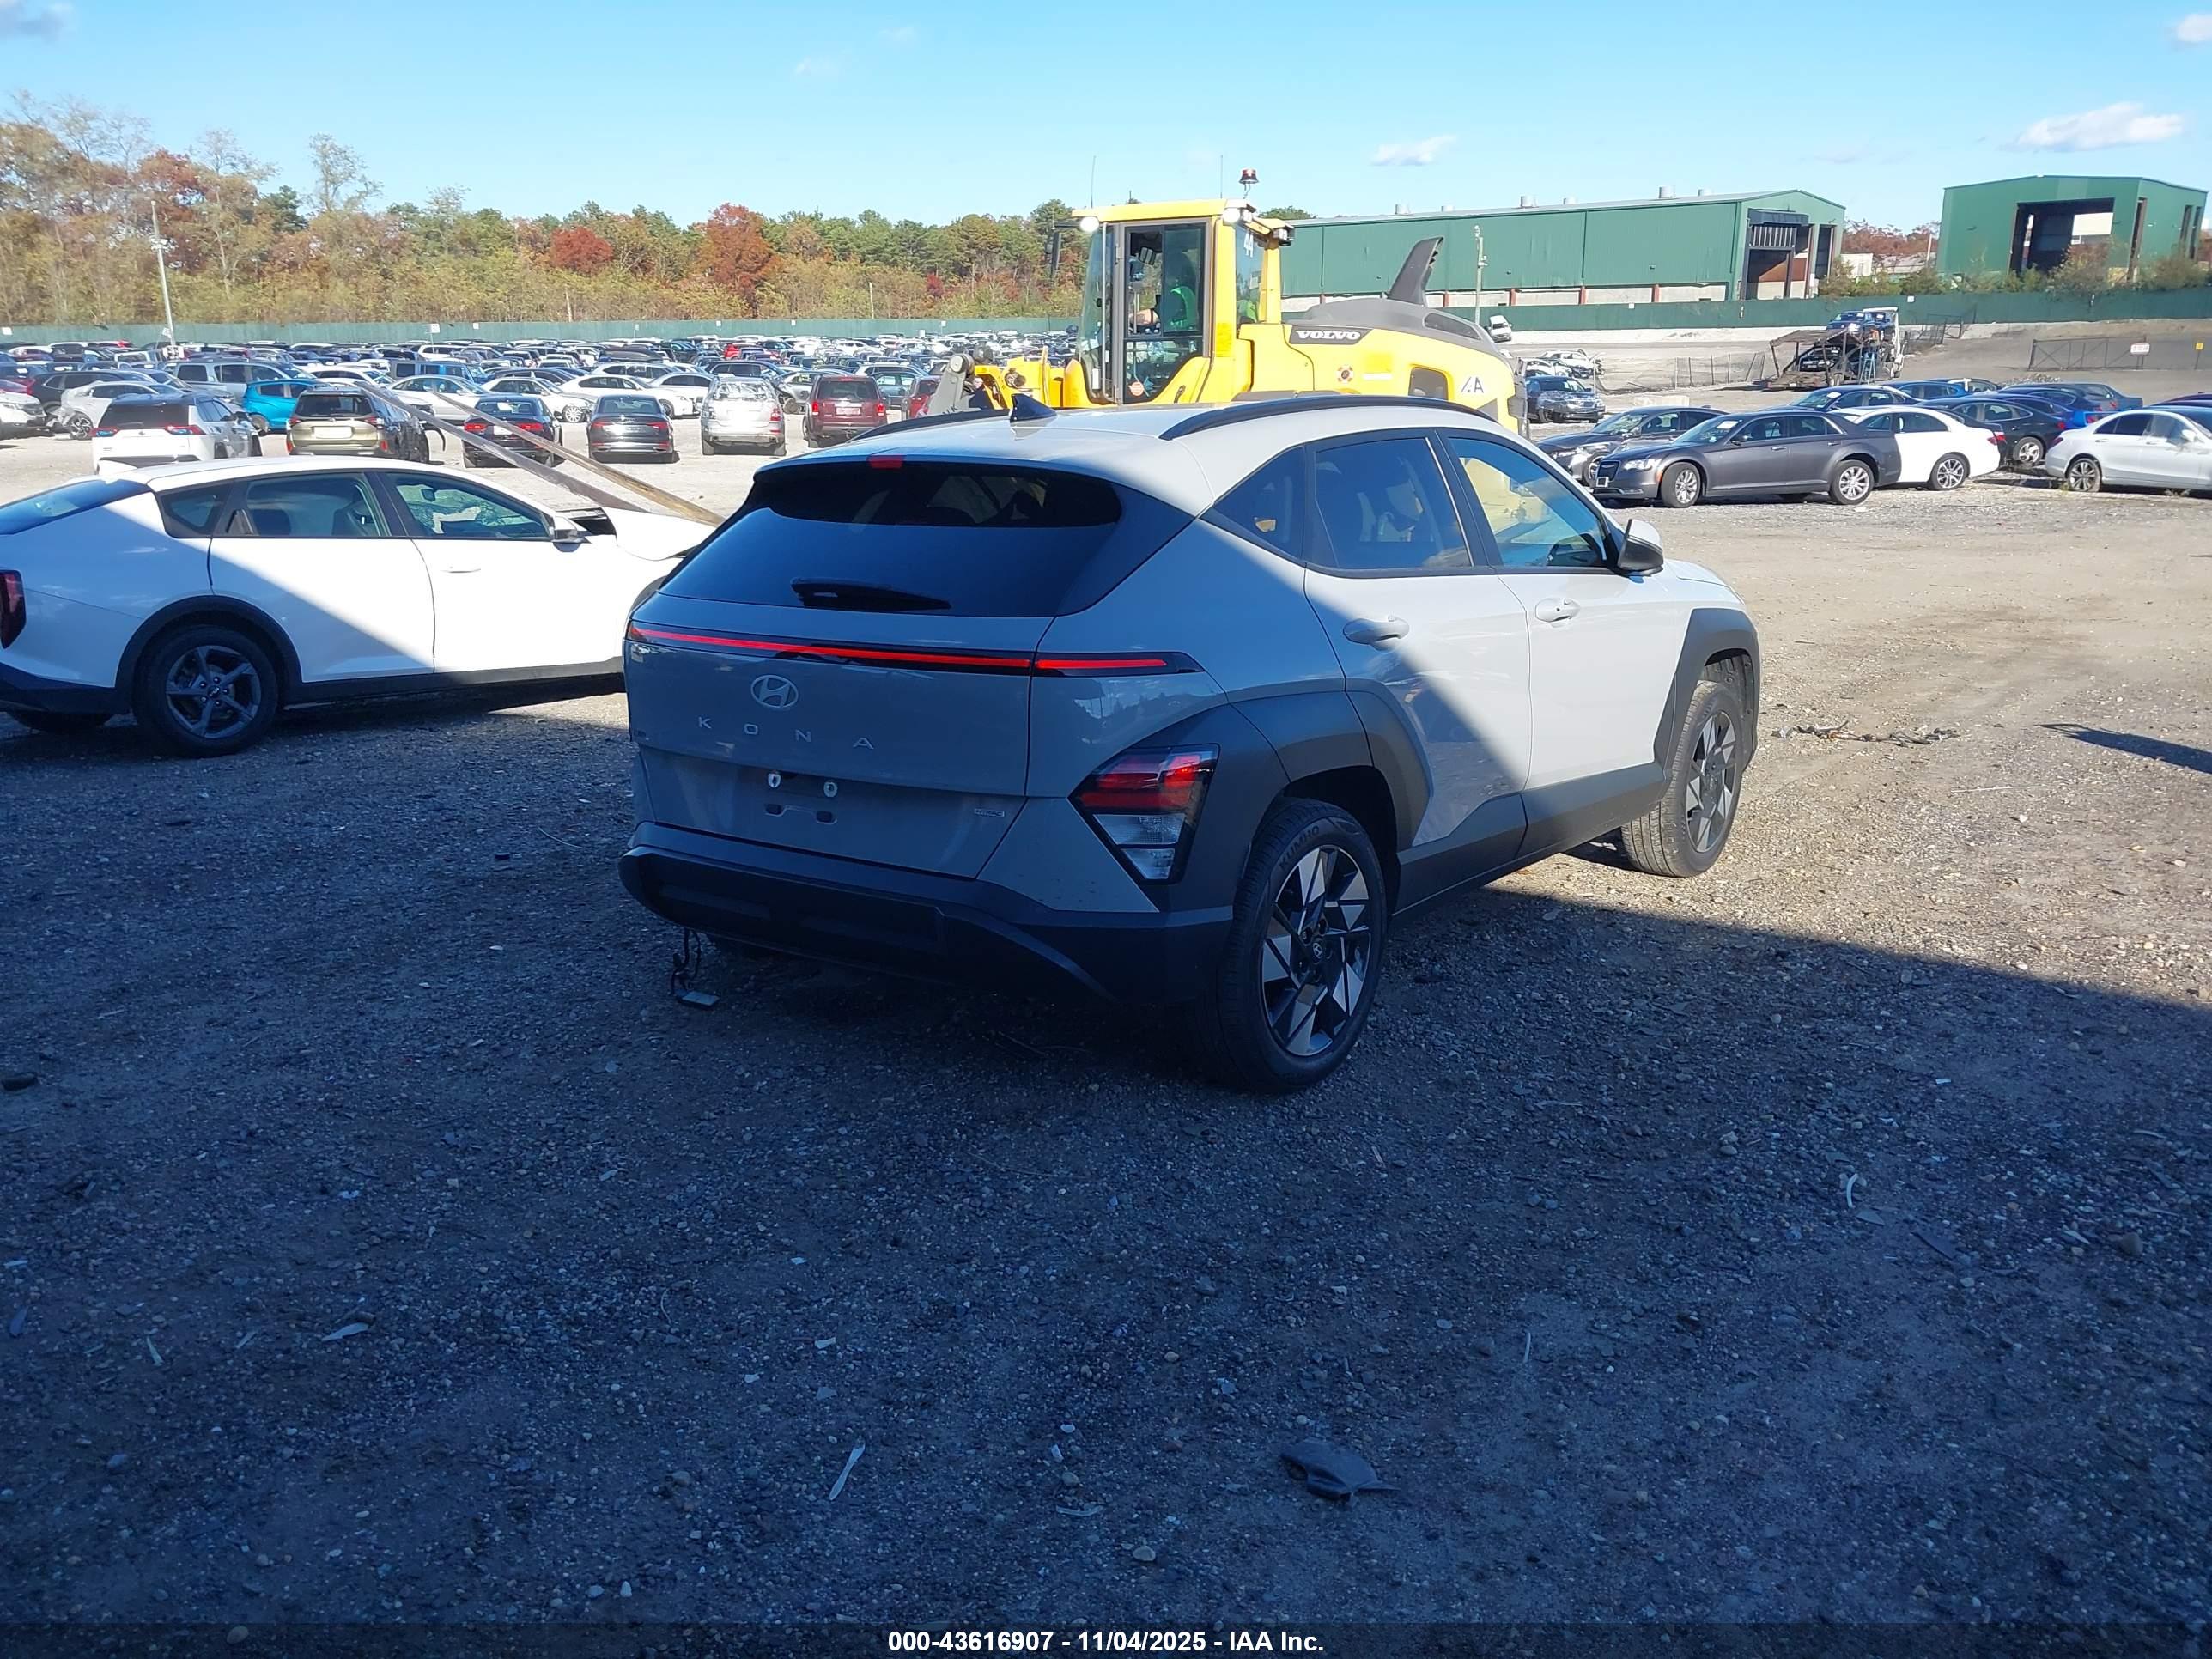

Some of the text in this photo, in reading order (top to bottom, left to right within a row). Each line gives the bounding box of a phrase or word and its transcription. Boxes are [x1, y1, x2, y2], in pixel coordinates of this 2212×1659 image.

[1295, 330, 1361, 340] VOLVO
[697, 716, 875, 750] KONA
[1279, 824, 1321, 871] KUMHO
